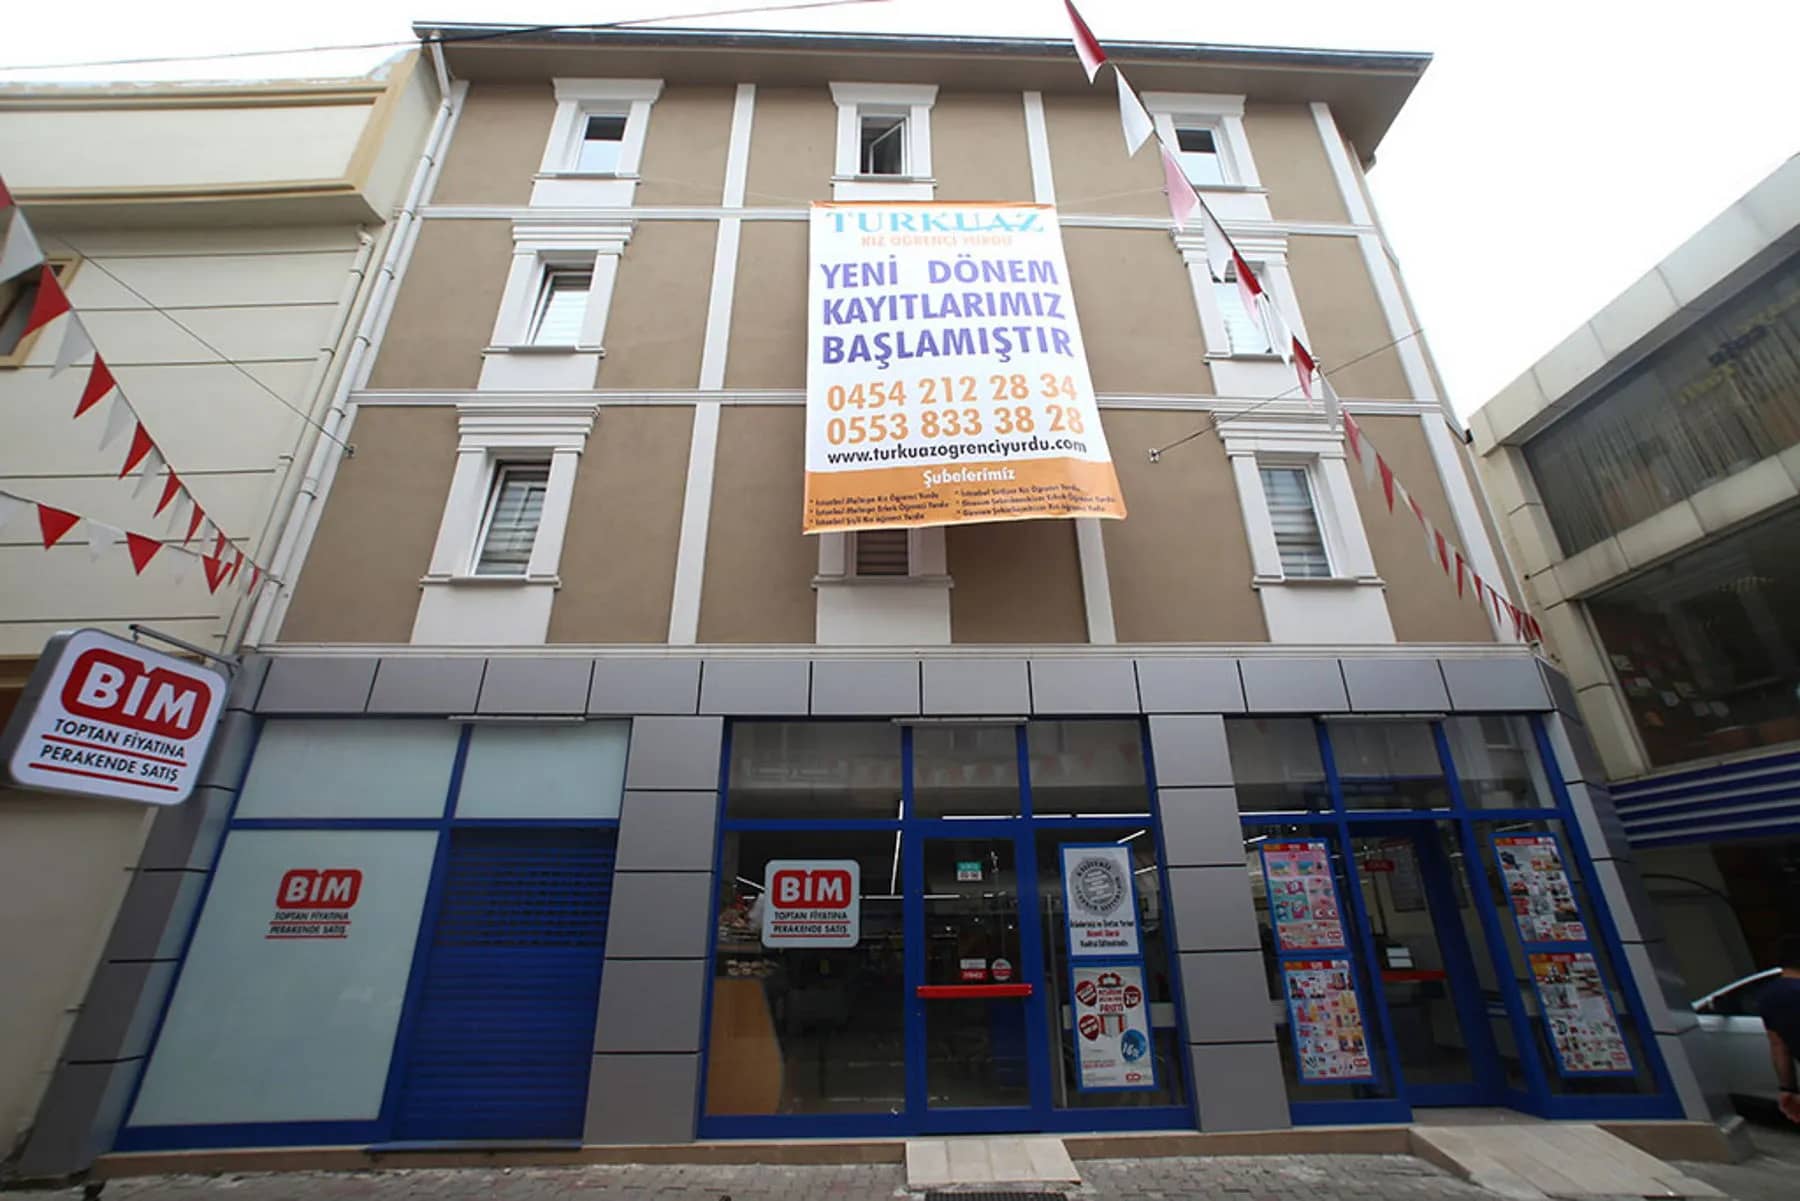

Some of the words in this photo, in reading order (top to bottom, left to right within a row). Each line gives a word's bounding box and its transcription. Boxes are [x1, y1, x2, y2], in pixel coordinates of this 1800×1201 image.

[826, 212, 1045, 233] TURKUAZ
[820, 254, 898, 289] YENİ
[928, 253, 1059, 285] DÖNEM
[822, 291, 1066, 326] KAYITLARIMIZ
[822, 326, 1075, 370] BAŞLAMIŞTIR
[827, 380, 907, 411] 0454
[918, 375, 978, 404] 212
[989, 373, 1030, 400] 28
[1040, 372, 1078, 400] 34
[826, 412, 909, 445] 0553
[920, 407, 983, 438] 833
[993, 405, 1035, 435] 38
[1045, 403, 1085, 434] 28
[827, 436, 1088, 464] www.turkuazogrenciyurdu.com
[922, 466, 1017, 488] Şubelerimiz
[53, 718, 120, 744] TOPTAN
[122, 732, 187, 759] FİYATINA
[40, 744, 137, 774] PERAKENDE
[141, 764, 178, 782] SATIŞ
